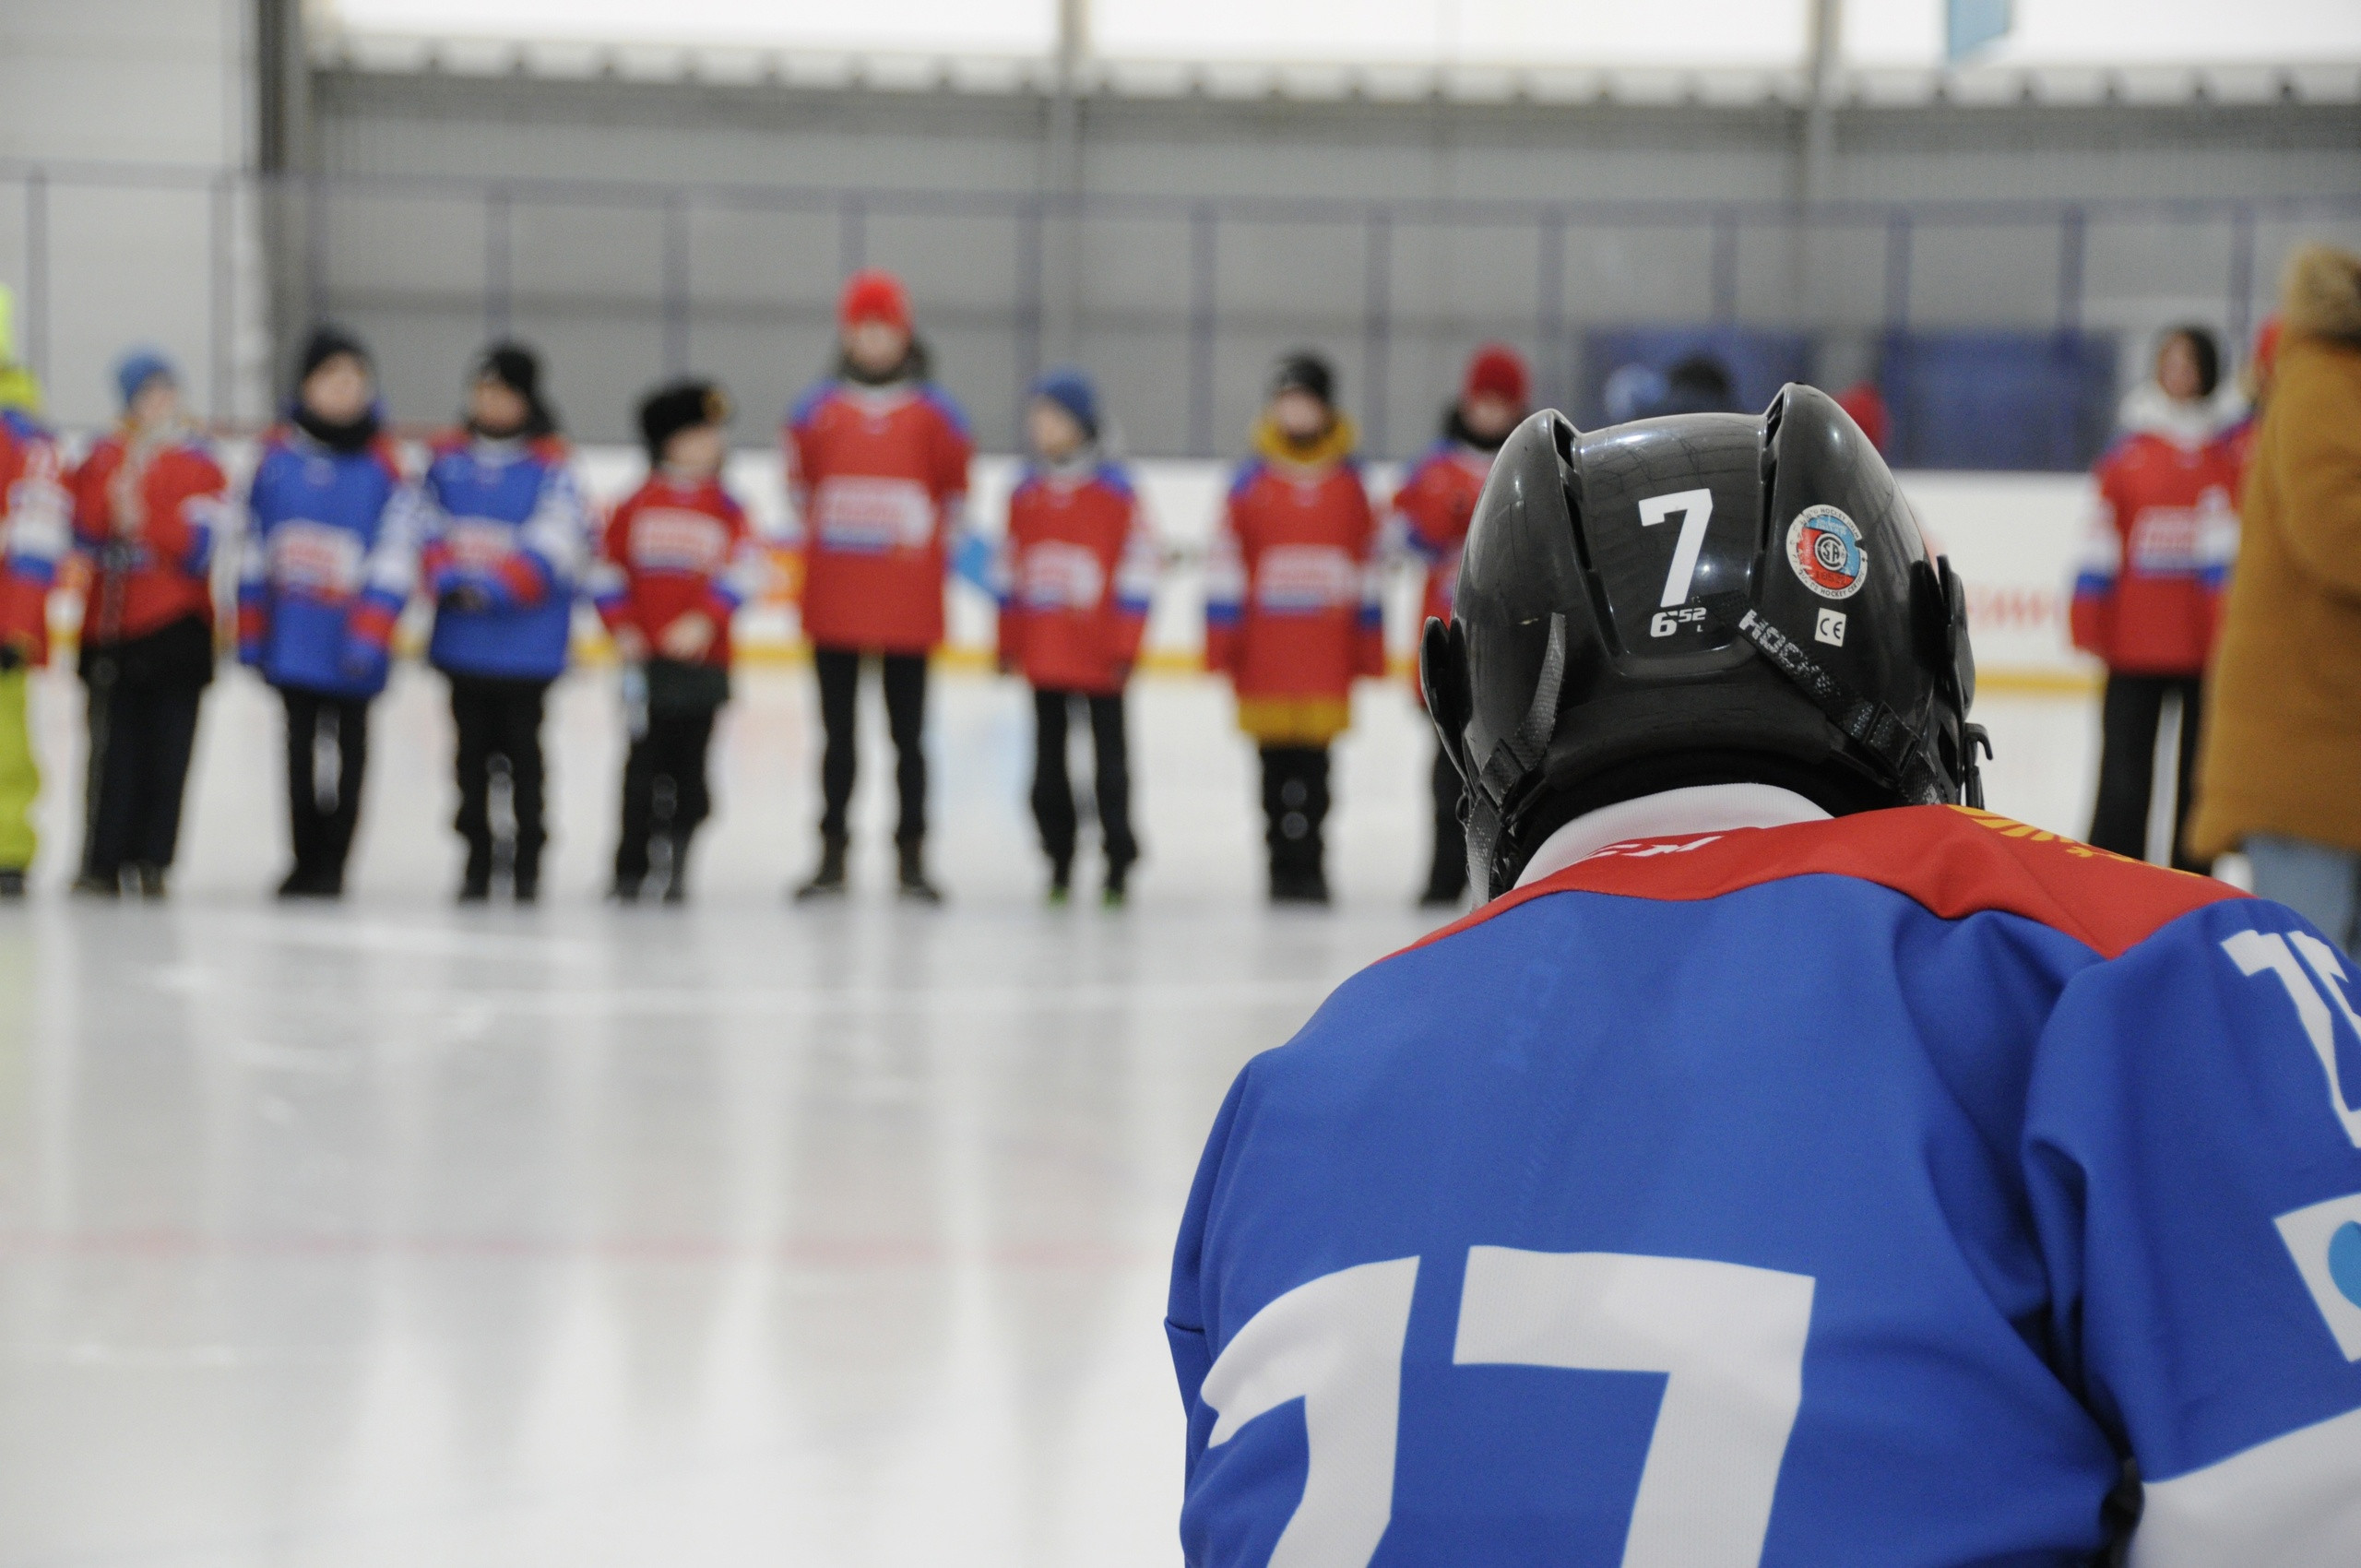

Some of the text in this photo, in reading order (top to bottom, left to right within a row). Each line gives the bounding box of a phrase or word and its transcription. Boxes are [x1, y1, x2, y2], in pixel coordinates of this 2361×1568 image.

[1638, 488, 1714, 608] 7
[1820, 588, 1847, 598] HOCKEY
[1820, 617, 1844, 640] CE
